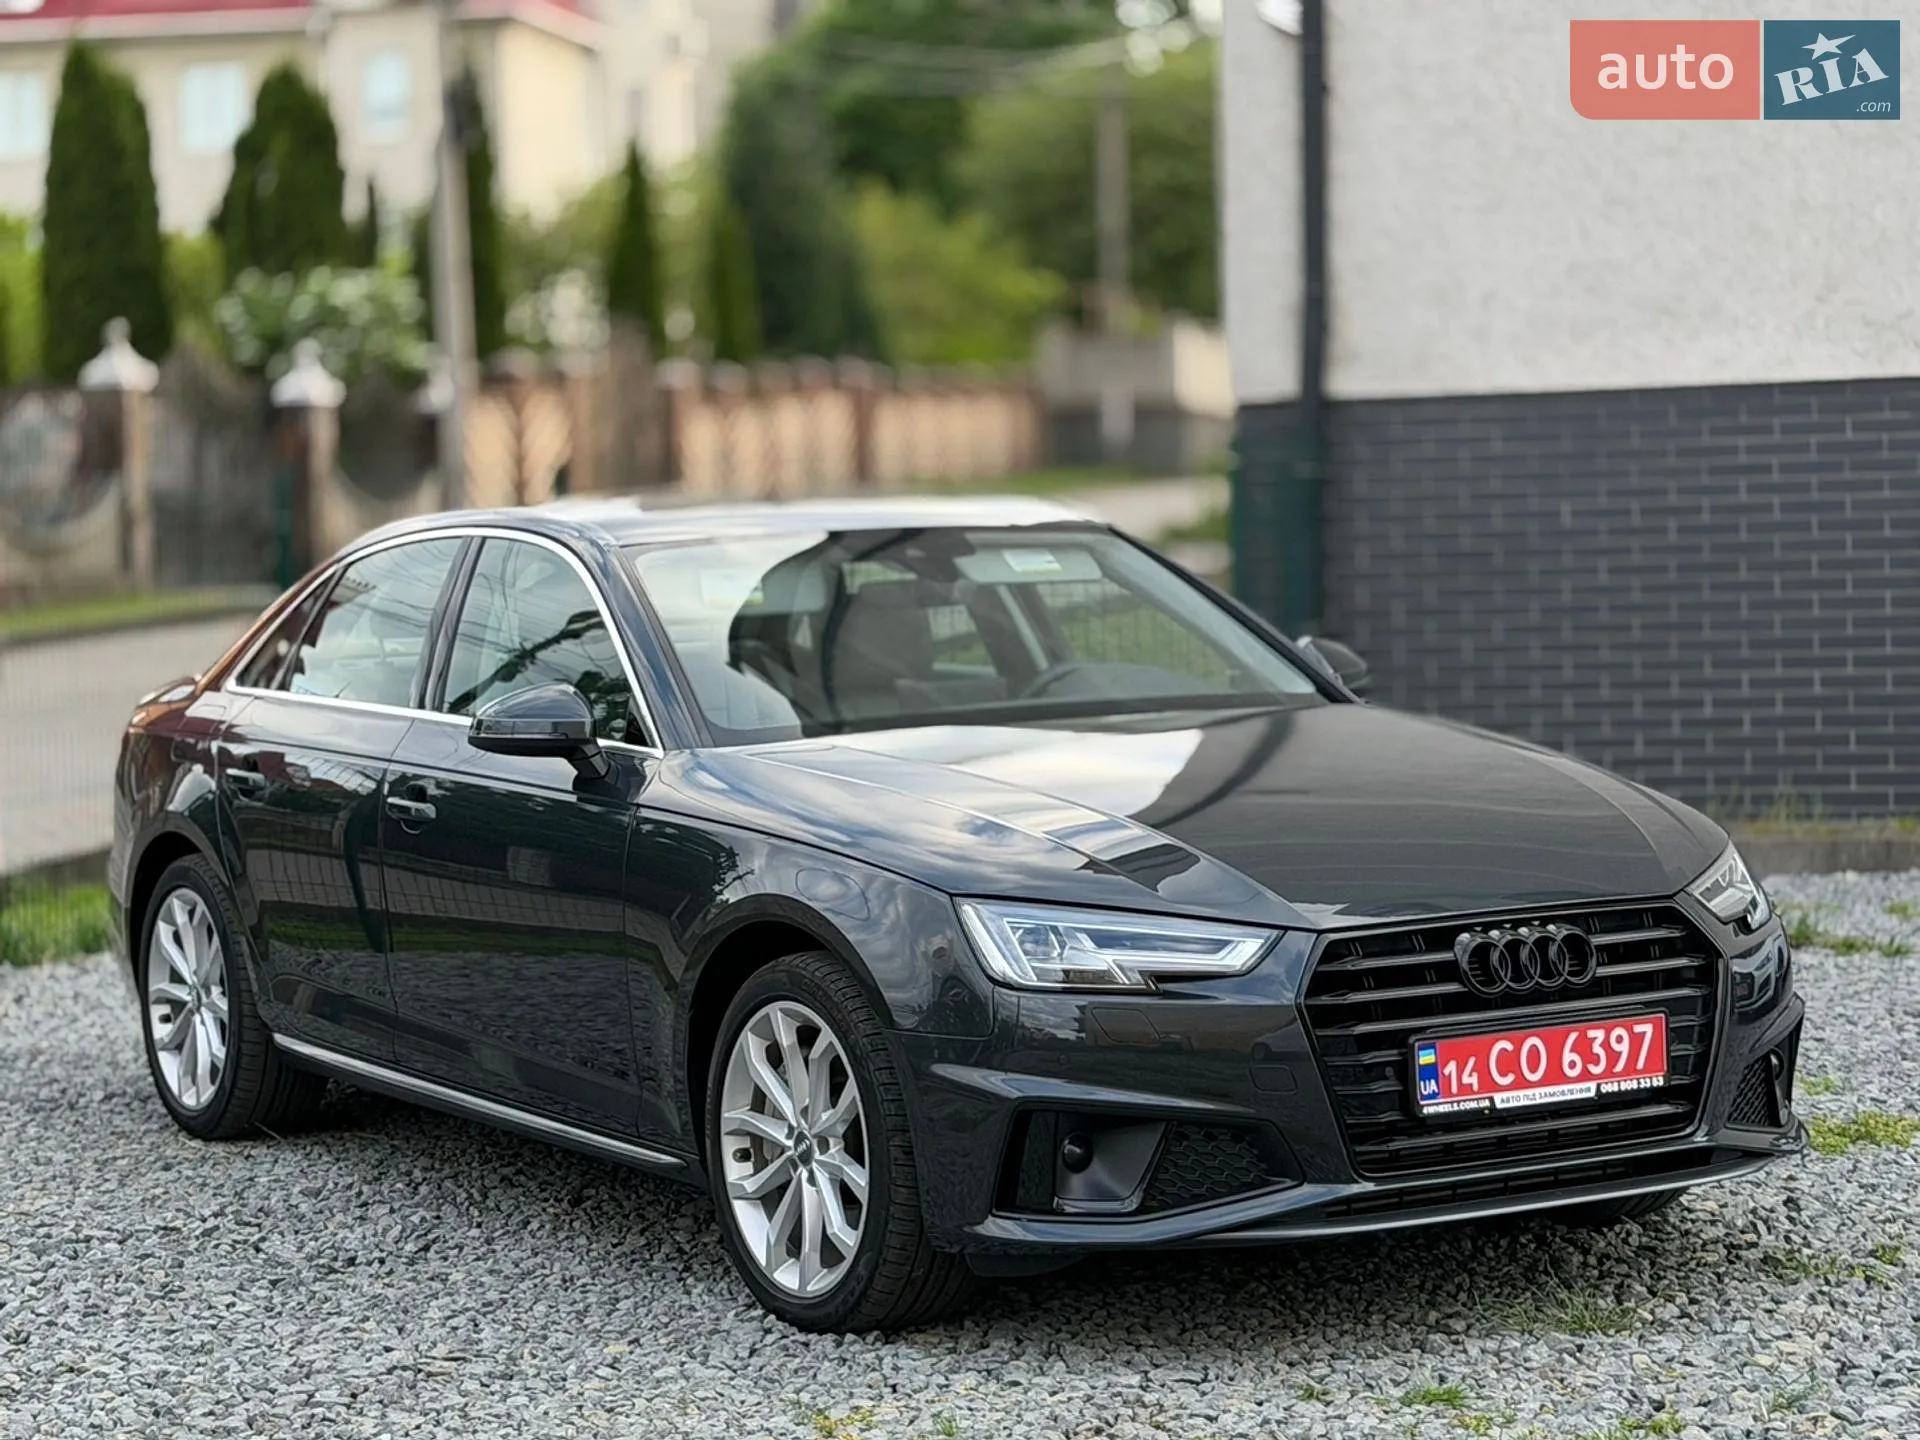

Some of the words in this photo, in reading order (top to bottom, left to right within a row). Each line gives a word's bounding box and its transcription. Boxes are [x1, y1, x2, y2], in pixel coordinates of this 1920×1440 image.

[1443, 1056, 1479, 1095] 14
[1488, 1036, 1548, 1086] CO
[1561, 1023, 1654, 1078] 6397
[1420, 1079, 1439, 1096] UA
[1499, 1094, 1522, 1105] АВТО
